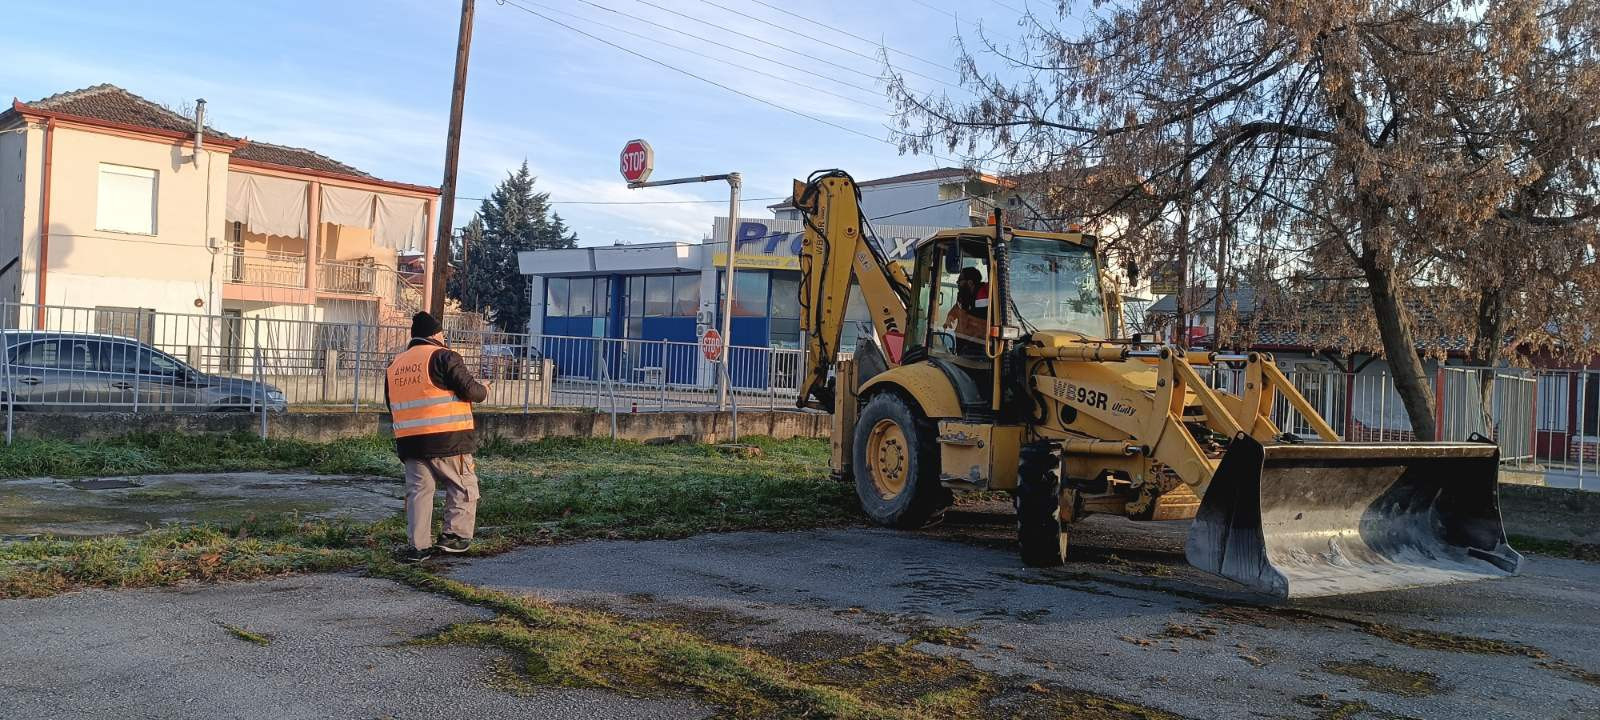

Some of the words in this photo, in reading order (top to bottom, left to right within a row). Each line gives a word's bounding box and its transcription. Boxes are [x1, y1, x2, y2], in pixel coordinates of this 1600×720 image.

[622, 150, 645, 172] STOP
[703, 337, 721, 352] STOP
[394, 363, 422, 376] ΔΗΜΟΣ
[1054, 381, 1108, 409] WB93R
